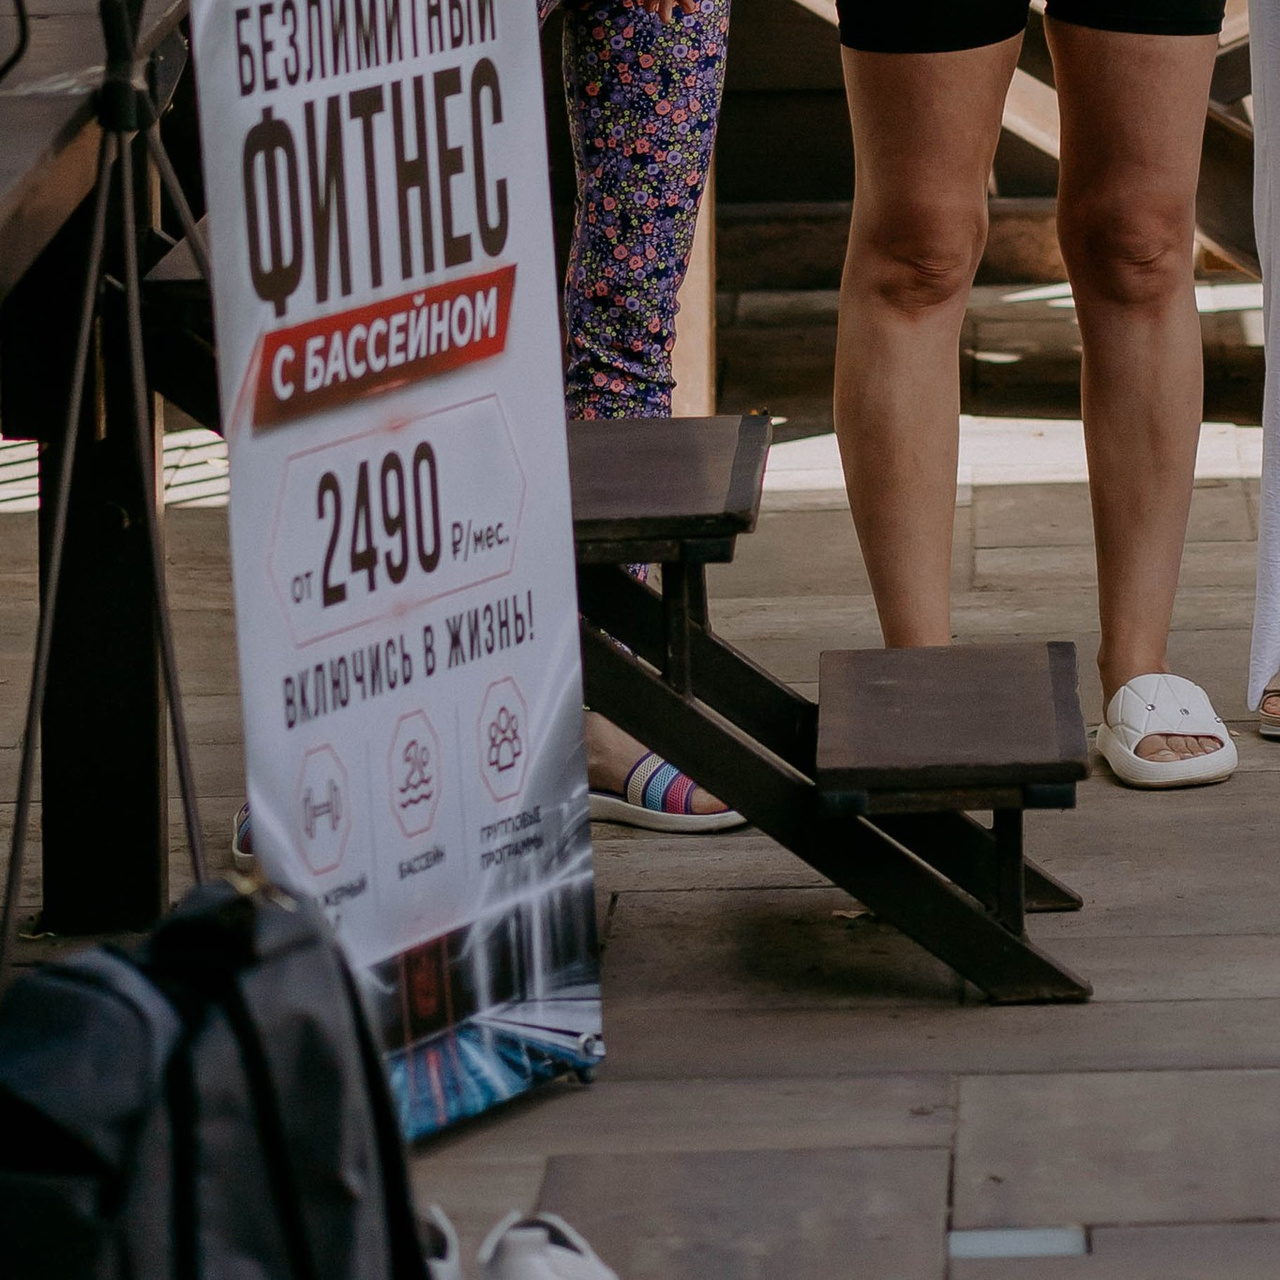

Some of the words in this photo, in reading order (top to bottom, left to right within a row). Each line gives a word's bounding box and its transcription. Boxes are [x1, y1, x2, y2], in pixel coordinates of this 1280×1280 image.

[243, 57, 510, 318] ФИТНЕС
[271, 344, 295, 401] С
[304, 286, 498, 393] БАССЕЙНОМ
[317, 441, 441, 607] 2490
[283, 634, 413, 730] ВКЛЮЧИСЬ
[423, 625, 436, 676] В
[446, 589, 534, 668] ЖИЗНЬ!
